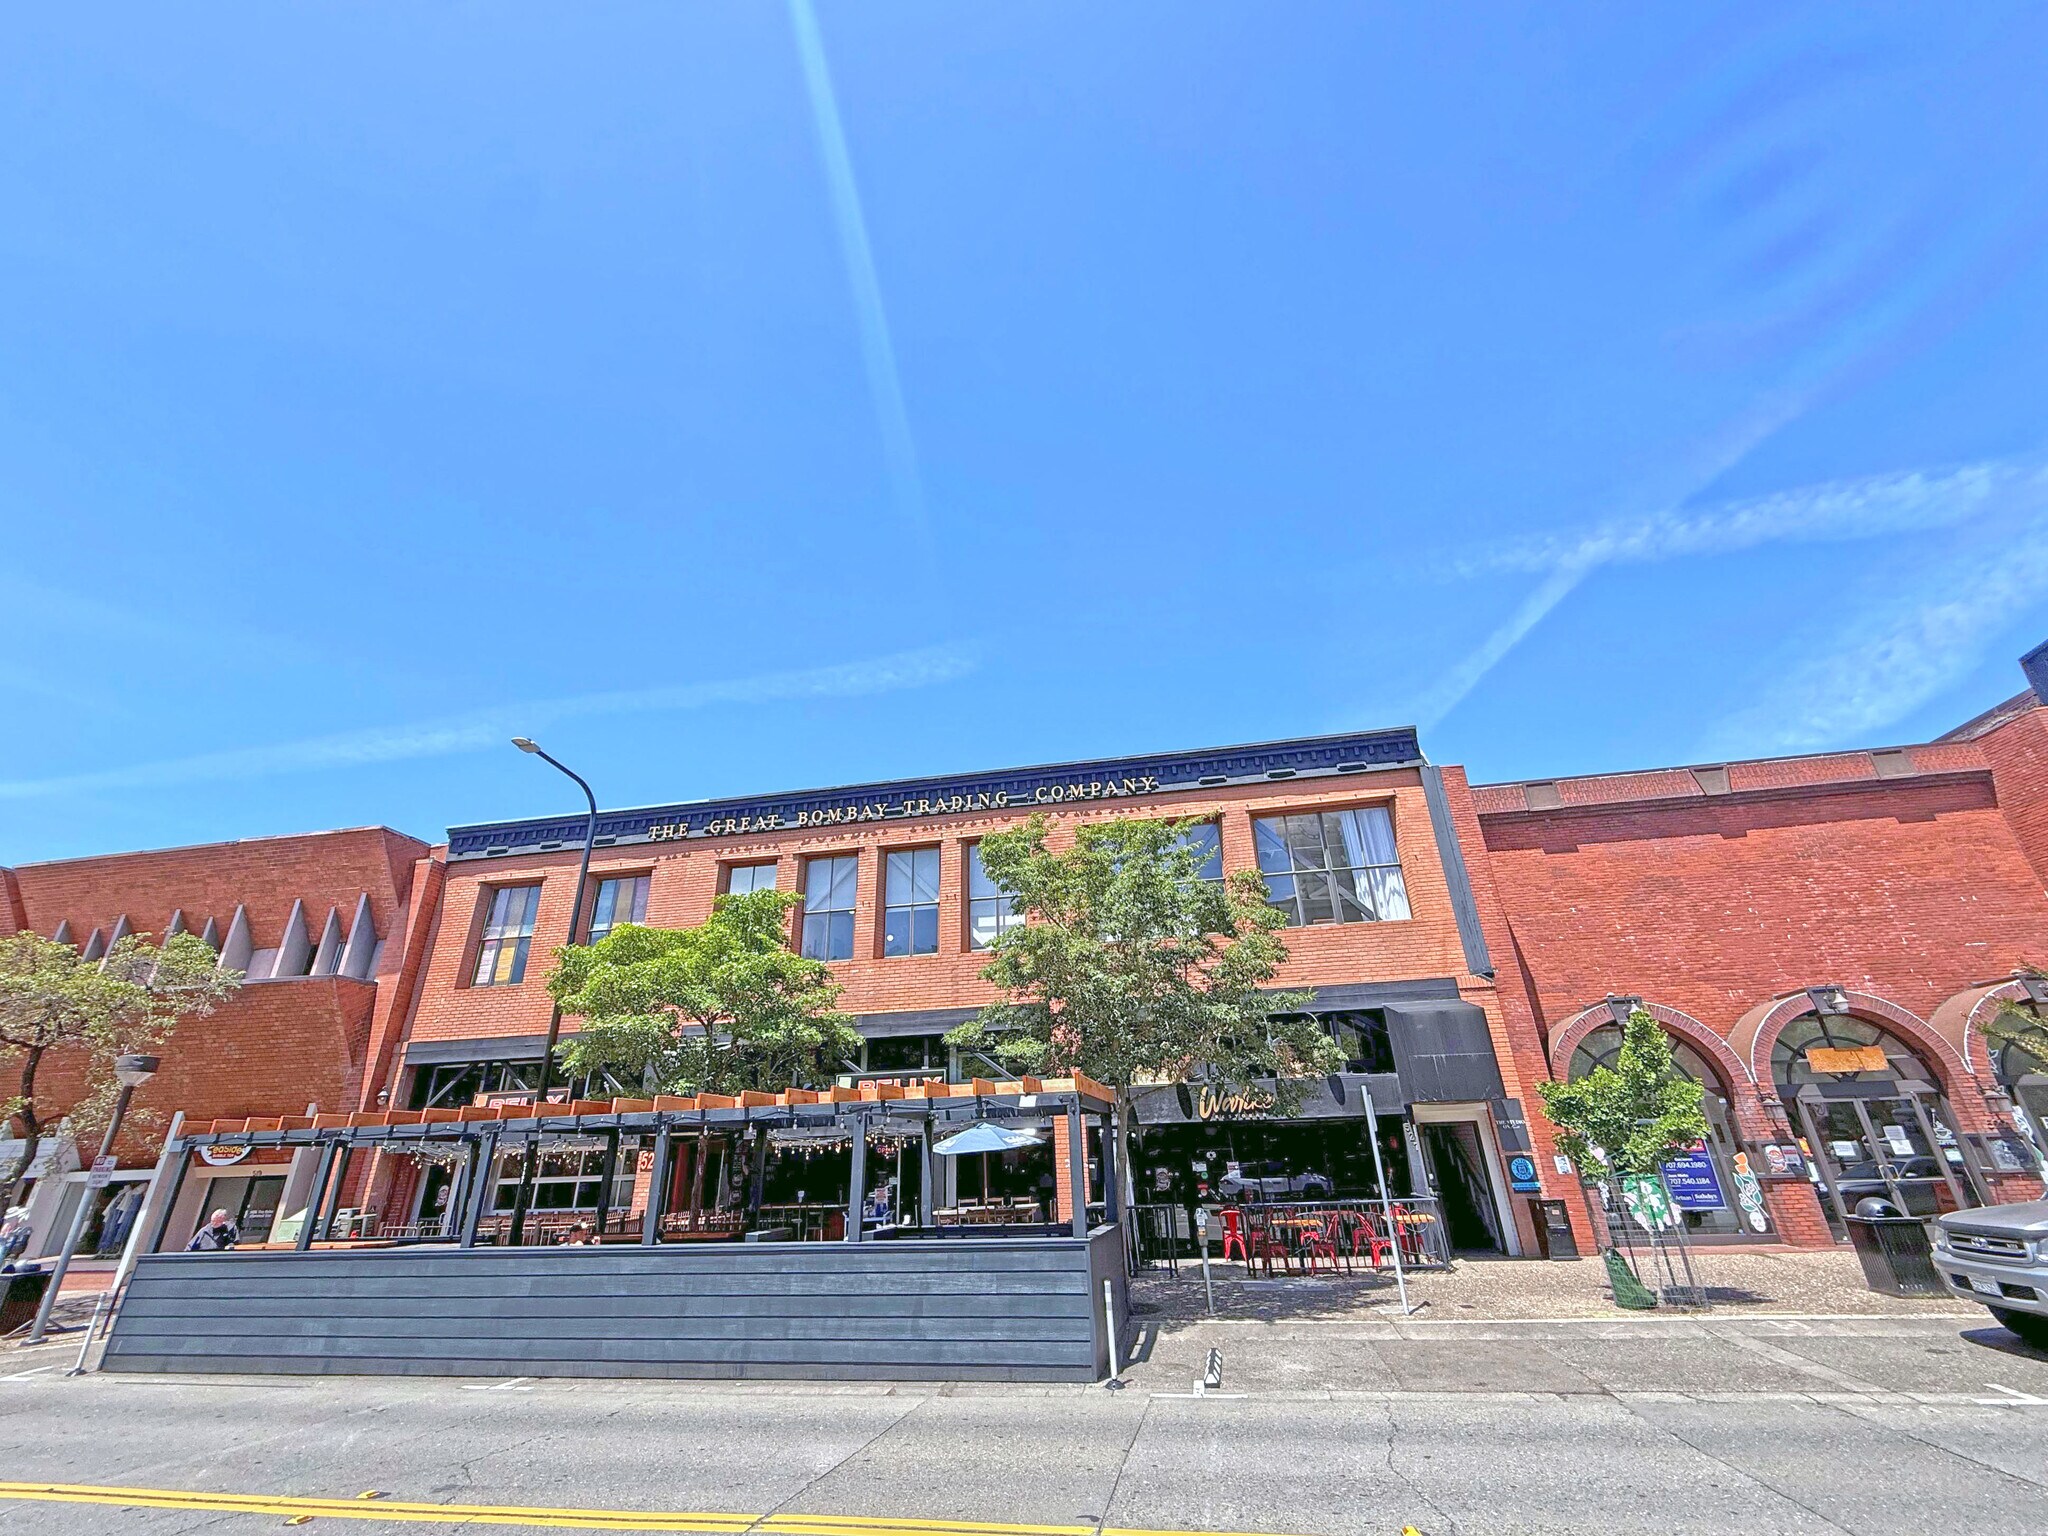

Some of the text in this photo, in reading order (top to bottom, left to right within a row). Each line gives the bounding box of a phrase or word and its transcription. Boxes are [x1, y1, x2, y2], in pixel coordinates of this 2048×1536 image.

[649, 776, 1155, 839] THE GREAT BOMBAY TRADING COMPANY
[489, 1094, 565, 1109] BELY
